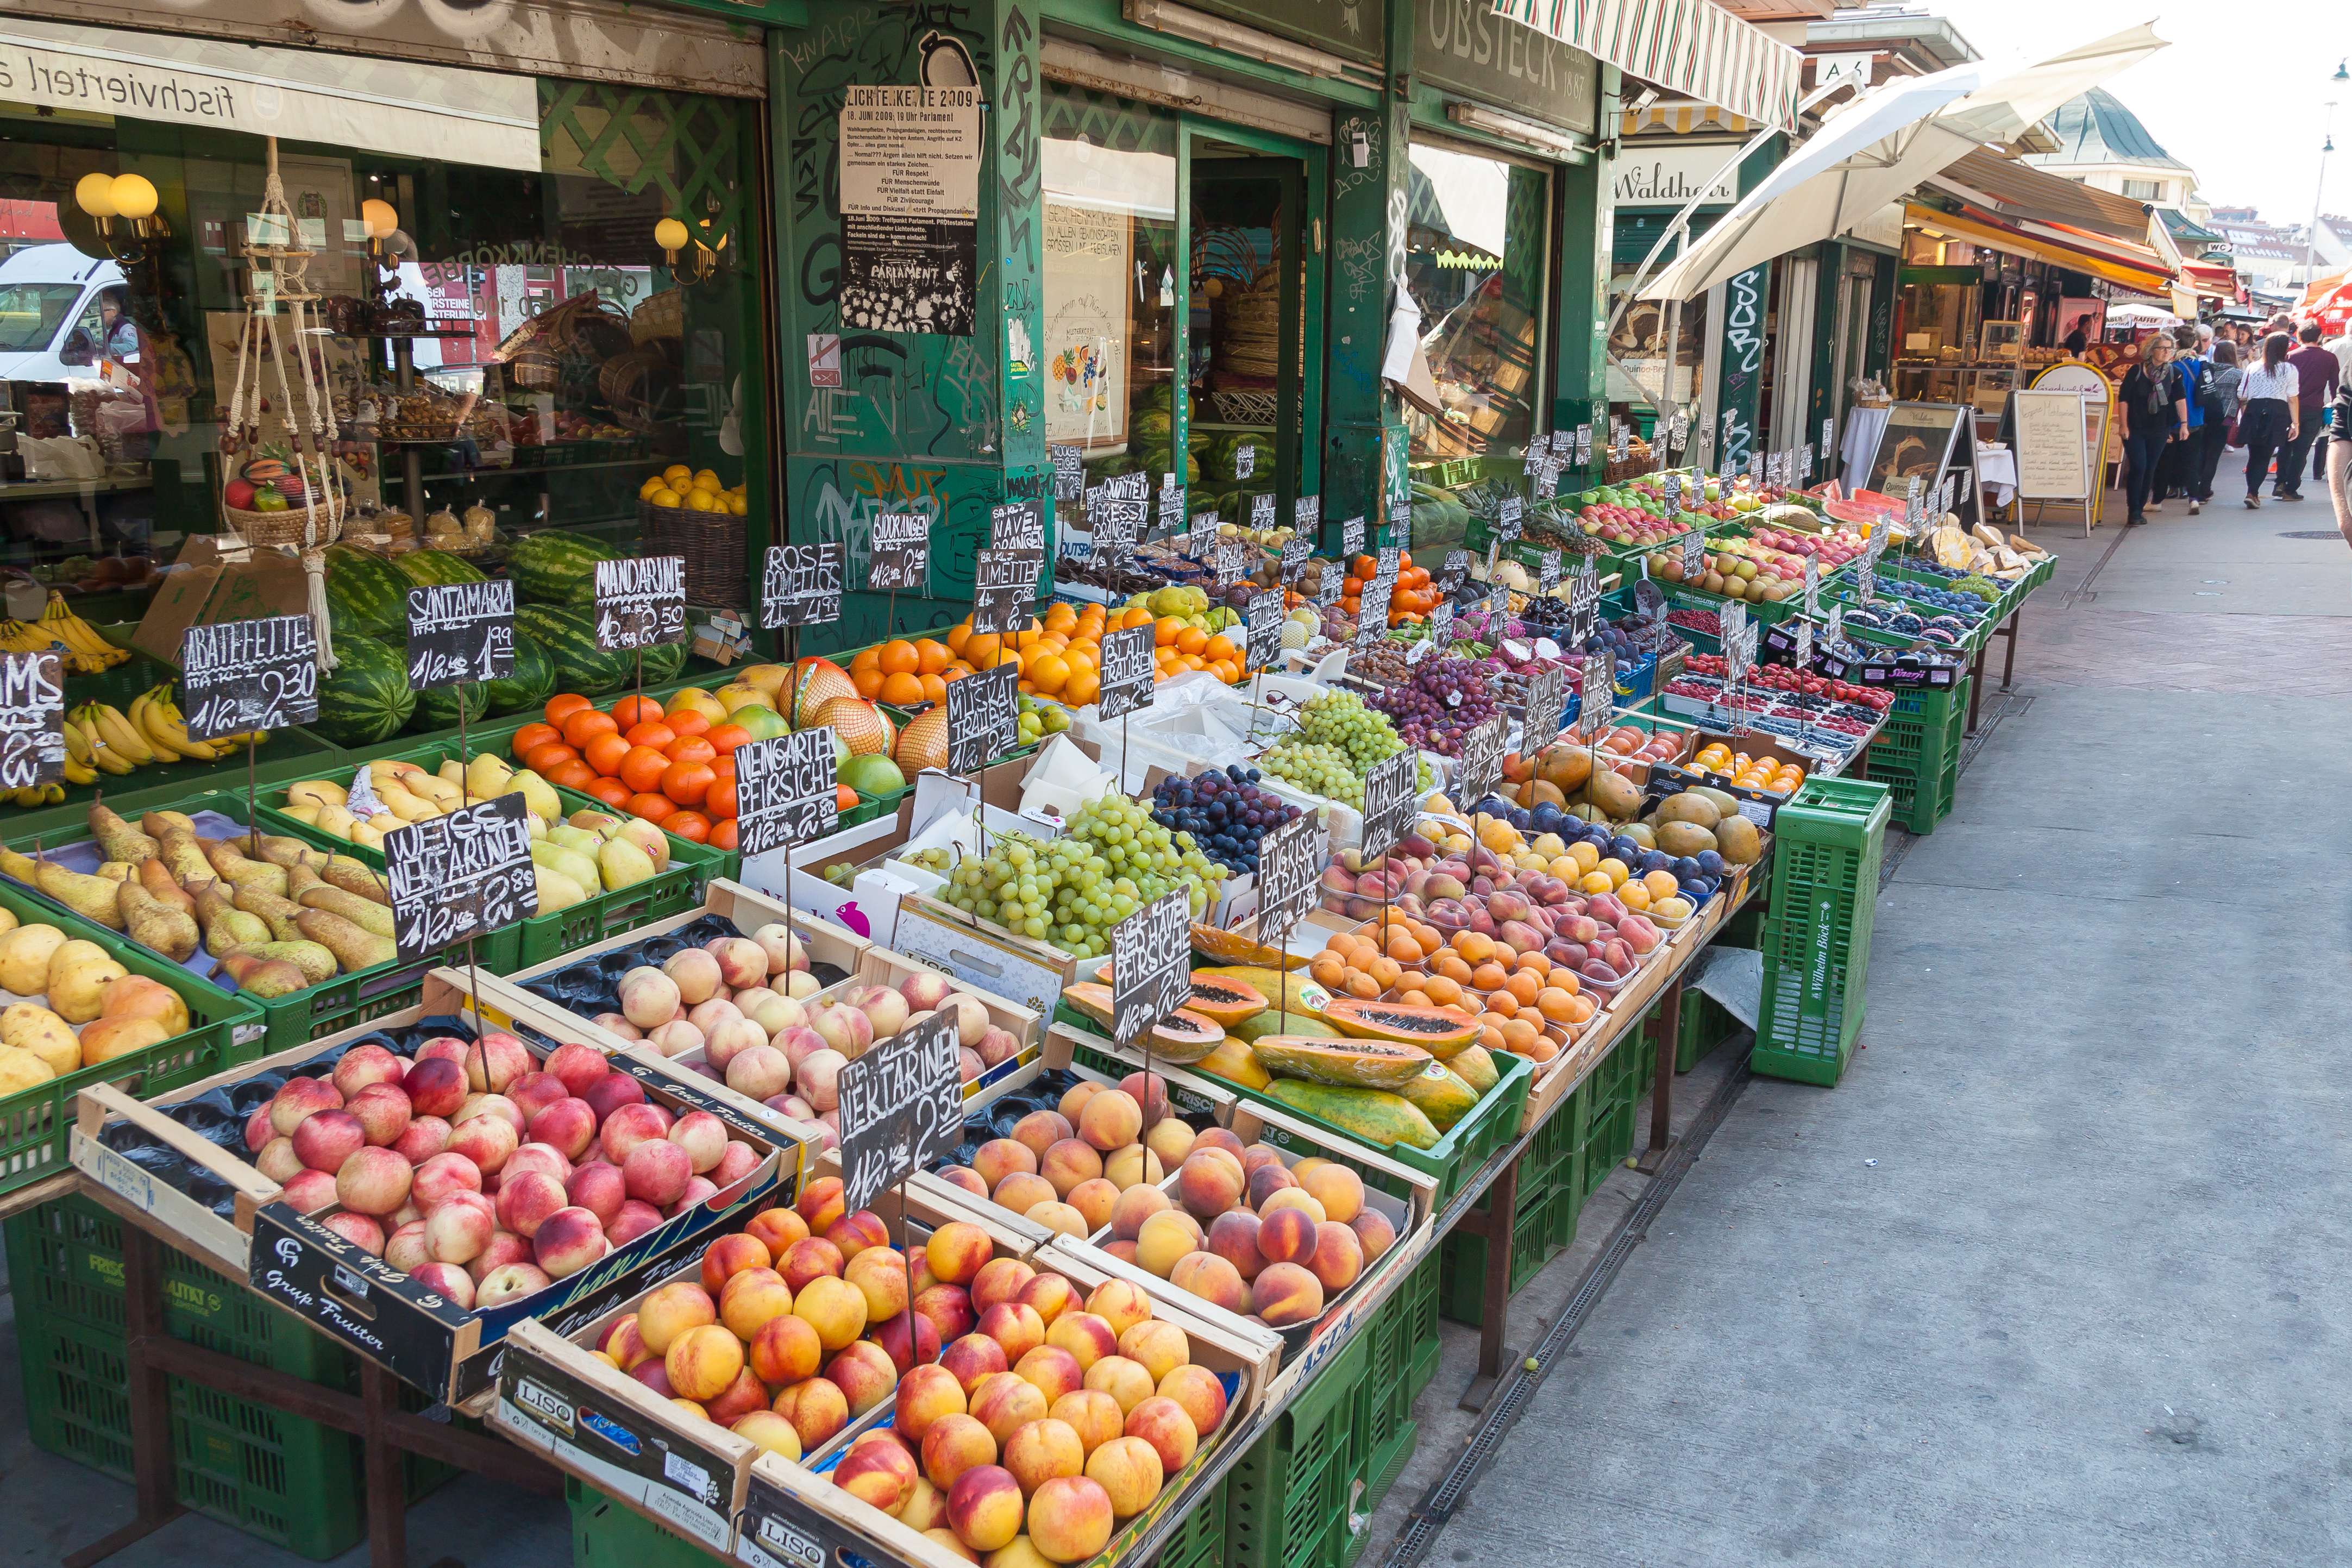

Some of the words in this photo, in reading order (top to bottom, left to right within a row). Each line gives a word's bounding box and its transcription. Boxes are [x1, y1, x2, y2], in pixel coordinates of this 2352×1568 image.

[1564, 70, 1585, 102] 1887
[1825, 64, 1840, 80] A
[848, 111, 857, 121] 18.
[859, 111, 873, 121] JUNI
[898, 112, 904, 121] 19
[906, 112, 917, 122] Uhr
[920, 112, 953, 122] Parlament
[928, 206, 975, 215] Propagandalügen
[1048, 225, 1053, 237] IN
[1057, 226, 1076, 238] ALLEN
[2210, 243, 2226, 251] WC
[871, 265, 939, 279] PARLAMENT
[1051, 444, 1081, 457] TROCKENE
[1053, 459, 1080, 470] FEIGEN
[1096, 503, 1139, 522] PRESS
[1256, 494, 1272, 509] KIWI
[873, 513, 929, 540] BIOORANGEN
[994, 512, 1043, 538] NAVEL
[1093, 522, 1138, 540] ORANGEN
[769, 543, 837, 572] ROSE
[977, 560, 1039, 586] LIMETTEN
[595, 556, 686, 598] MANDARINE
[764, 563, 842, 599] POMELLOS
[1572, 570, 1598, 605] KAKI
[409, 579, 514, 624] SANTAMARIA
[1249, 598, 1284, 631] TRAUBEN
[1101, 649, 1155, 683] TRAUBEN
[1105, 636, 1146, 666] BLAU
[1888, 668, 1927, 680] Sinerji
[949, 673, 1018, 721] MUSKAT
[951, 695, 1019, 741] TRAUBEN
[1466, 714, 1501, 750] SATURN
[736, 725, 836, 784] WEINGARTEN
[1463, 730, 1506, 775] PFIRSICH
[737, 757, 838, 813] PFIRSICHE
[1365, 757, 1418, 819] MARILLEN
[390, 804, 505, 863] WEISS
[388, 818, 531, 902] NEKTARINEN
[1258, 826, 1319, 886] FLUGRISEN
[1264, 855, 1316, 910] PAPAYA
[1148, 897, 1190, 944] HAVEN
[1816, 922, 1830, 948] Böck
[1115, 930, 1191, 998] PFIRSICHE
[1811, 949, 1831, 1000] Wilhelm
[839, 1026, 961, 1137] NEKTARINEN
[266, 1270, 313, 1306] Grup
[319, 1297, 384, 1350] Fruiter
[554, 1293, 622, 1338] Grup
[523, 1385, 570, 1421] LISO
[765, 1522, 821, 1564] LISO
